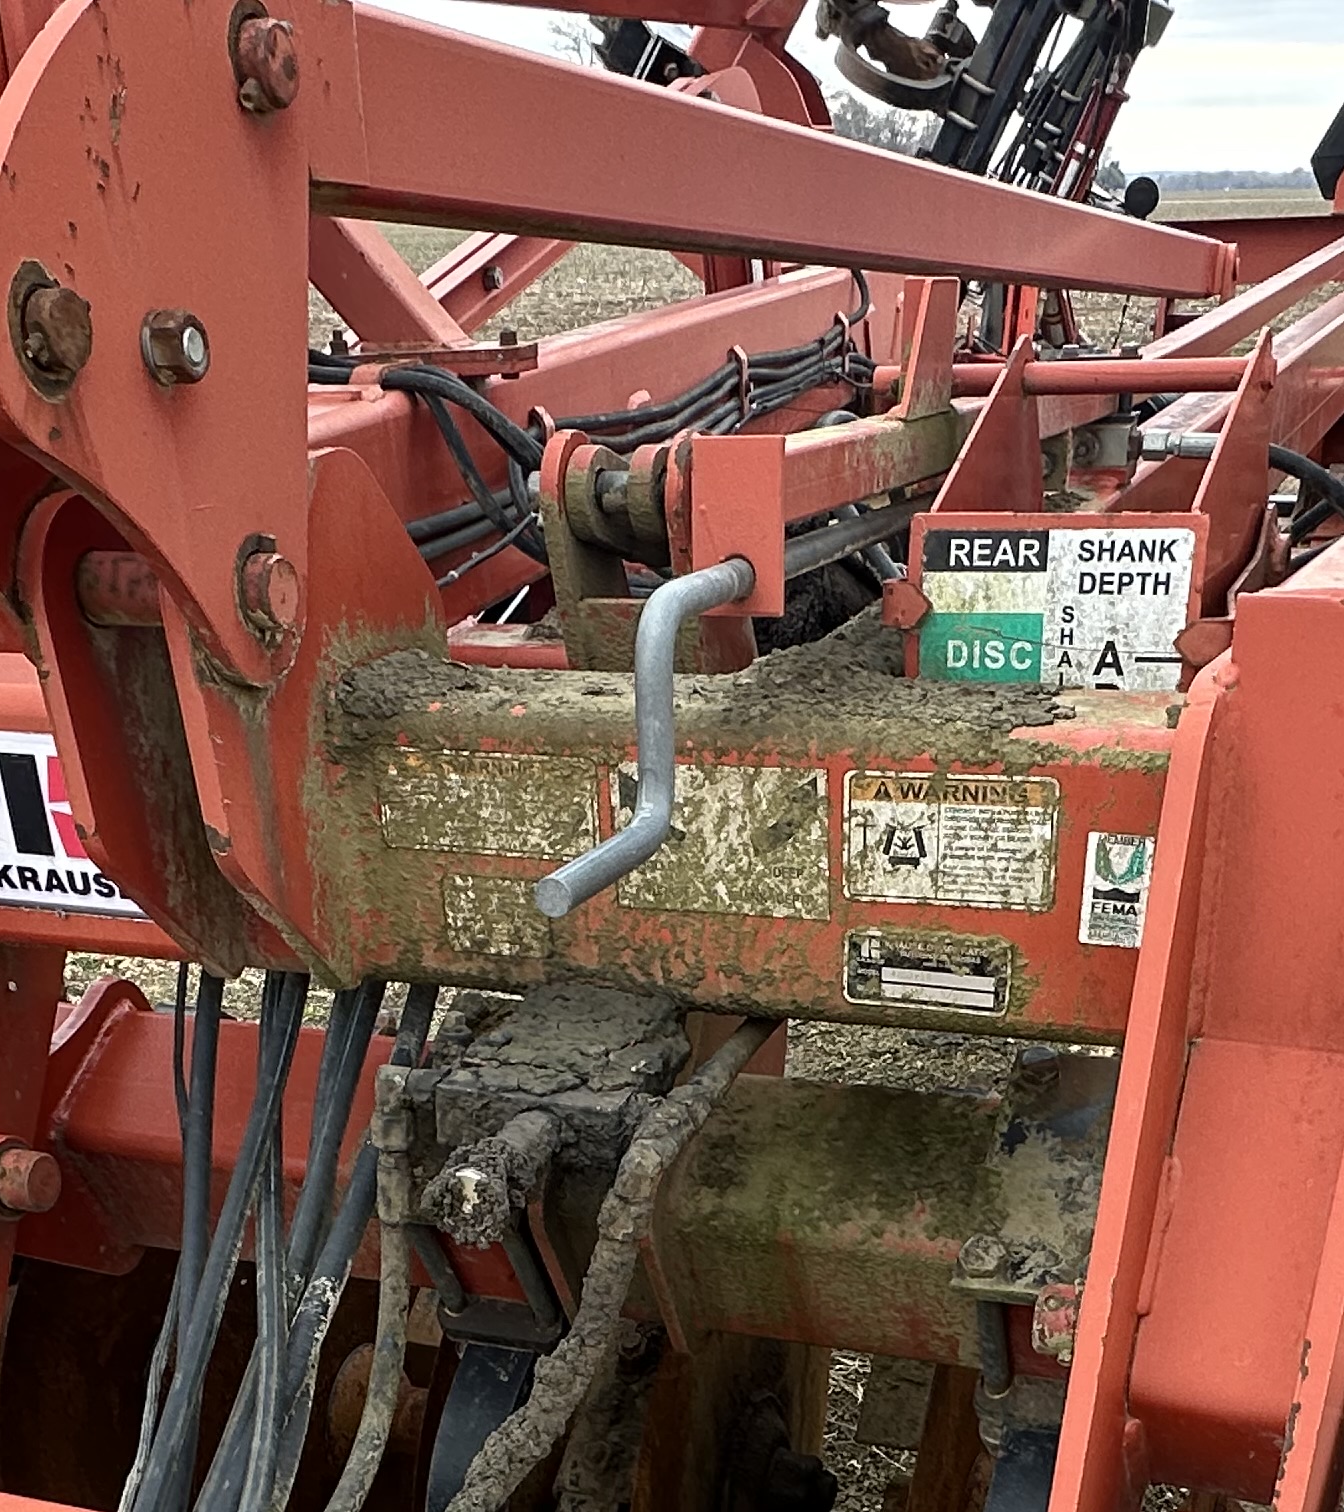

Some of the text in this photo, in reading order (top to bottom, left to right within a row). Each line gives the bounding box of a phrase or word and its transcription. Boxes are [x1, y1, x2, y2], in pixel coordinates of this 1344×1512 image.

[949, 538, 1040, 568] REAR
[1077, 539, 1178, 564] SHANK
[1078, 572, 1172, 597] DEPTH
[945, 640, 1034, 671] DISC
[1092, 641, 1125, 677] A
[1091, 901, 1138, 917] FEMA
